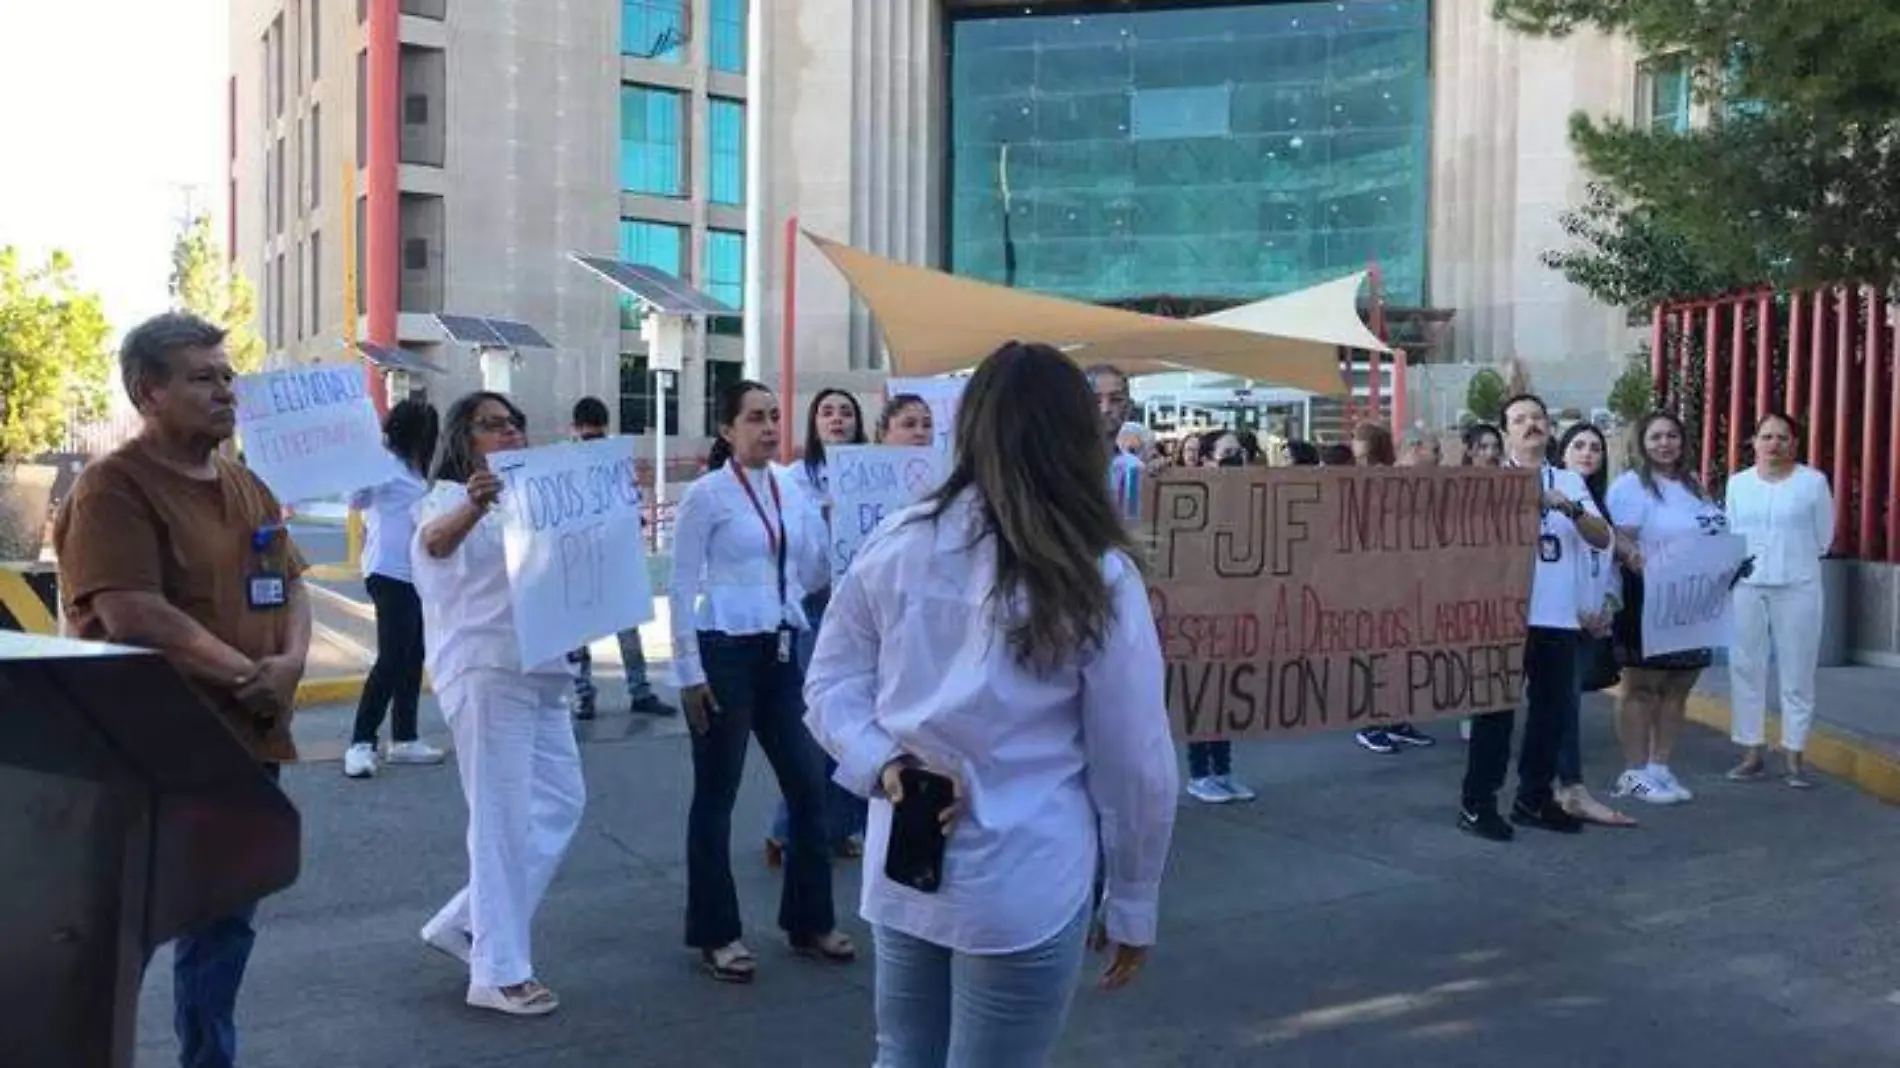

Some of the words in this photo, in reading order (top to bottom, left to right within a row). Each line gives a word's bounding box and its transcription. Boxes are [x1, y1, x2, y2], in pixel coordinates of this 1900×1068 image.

[1152, 481, 1320, 579] PJF
[1271, 583, 1290, 655] A
[1164, 656, 1331, 735] IVISION
[1347, 652, 1390, 721] DE
[1406, 643, 1522, 713] PODERE
